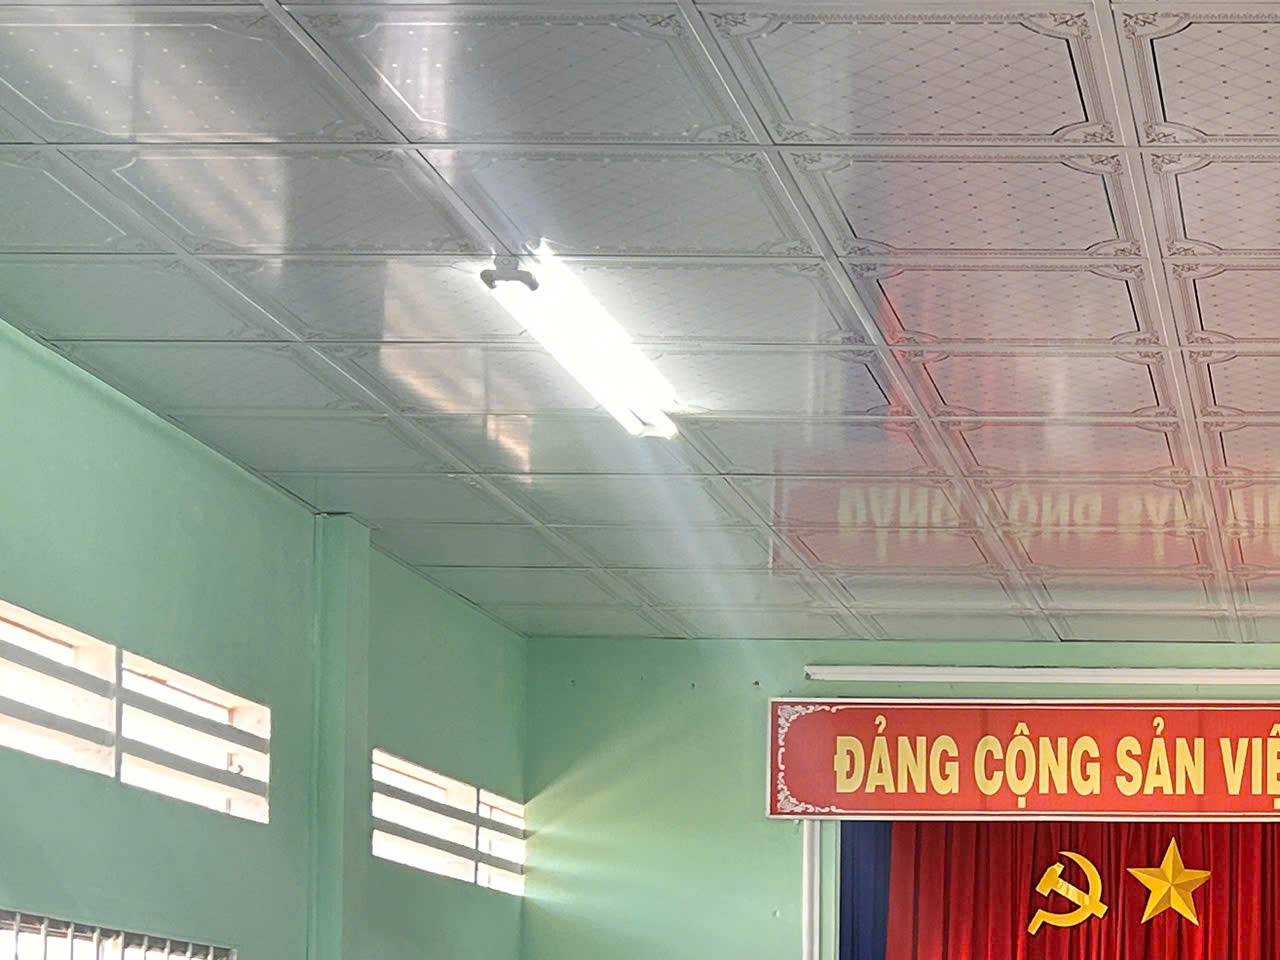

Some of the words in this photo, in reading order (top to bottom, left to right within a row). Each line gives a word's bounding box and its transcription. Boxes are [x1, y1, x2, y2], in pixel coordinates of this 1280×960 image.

[834, 716, 959, 796] ĐẢNG
[975, 722, 1100, 809] CỘNG
[1116, 716, 1204, 797] SẢN
